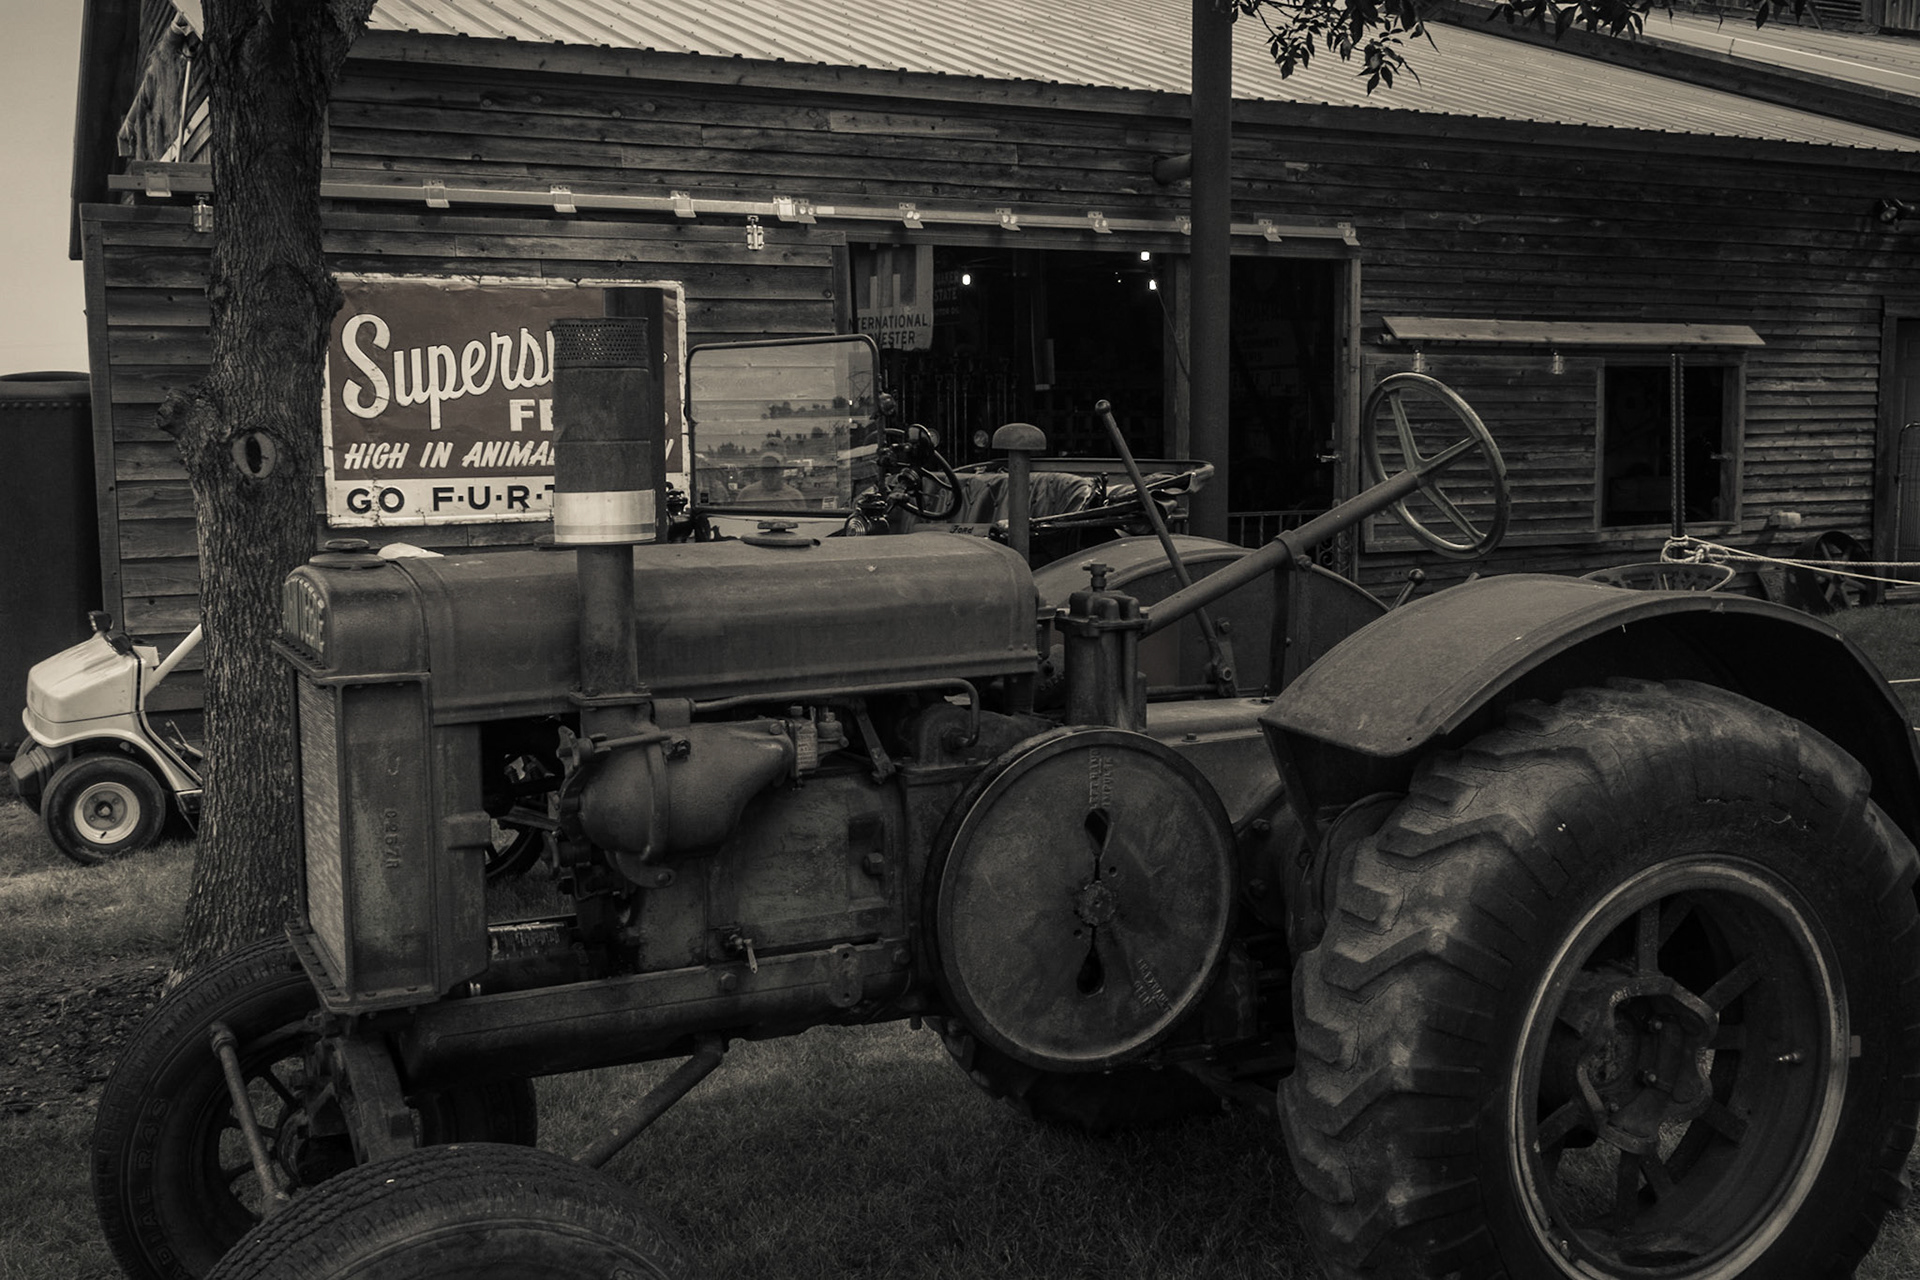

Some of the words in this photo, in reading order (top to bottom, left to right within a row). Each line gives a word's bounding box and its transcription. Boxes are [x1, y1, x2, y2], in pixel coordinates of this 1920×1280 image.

[341, 314, 555, 431] Supers
[343, 441, 411, 471] HIGH
[419, 440, 455, 469] IN
[346, 486, 406, 515] GO
[949, 525, 974, 534] Ford
